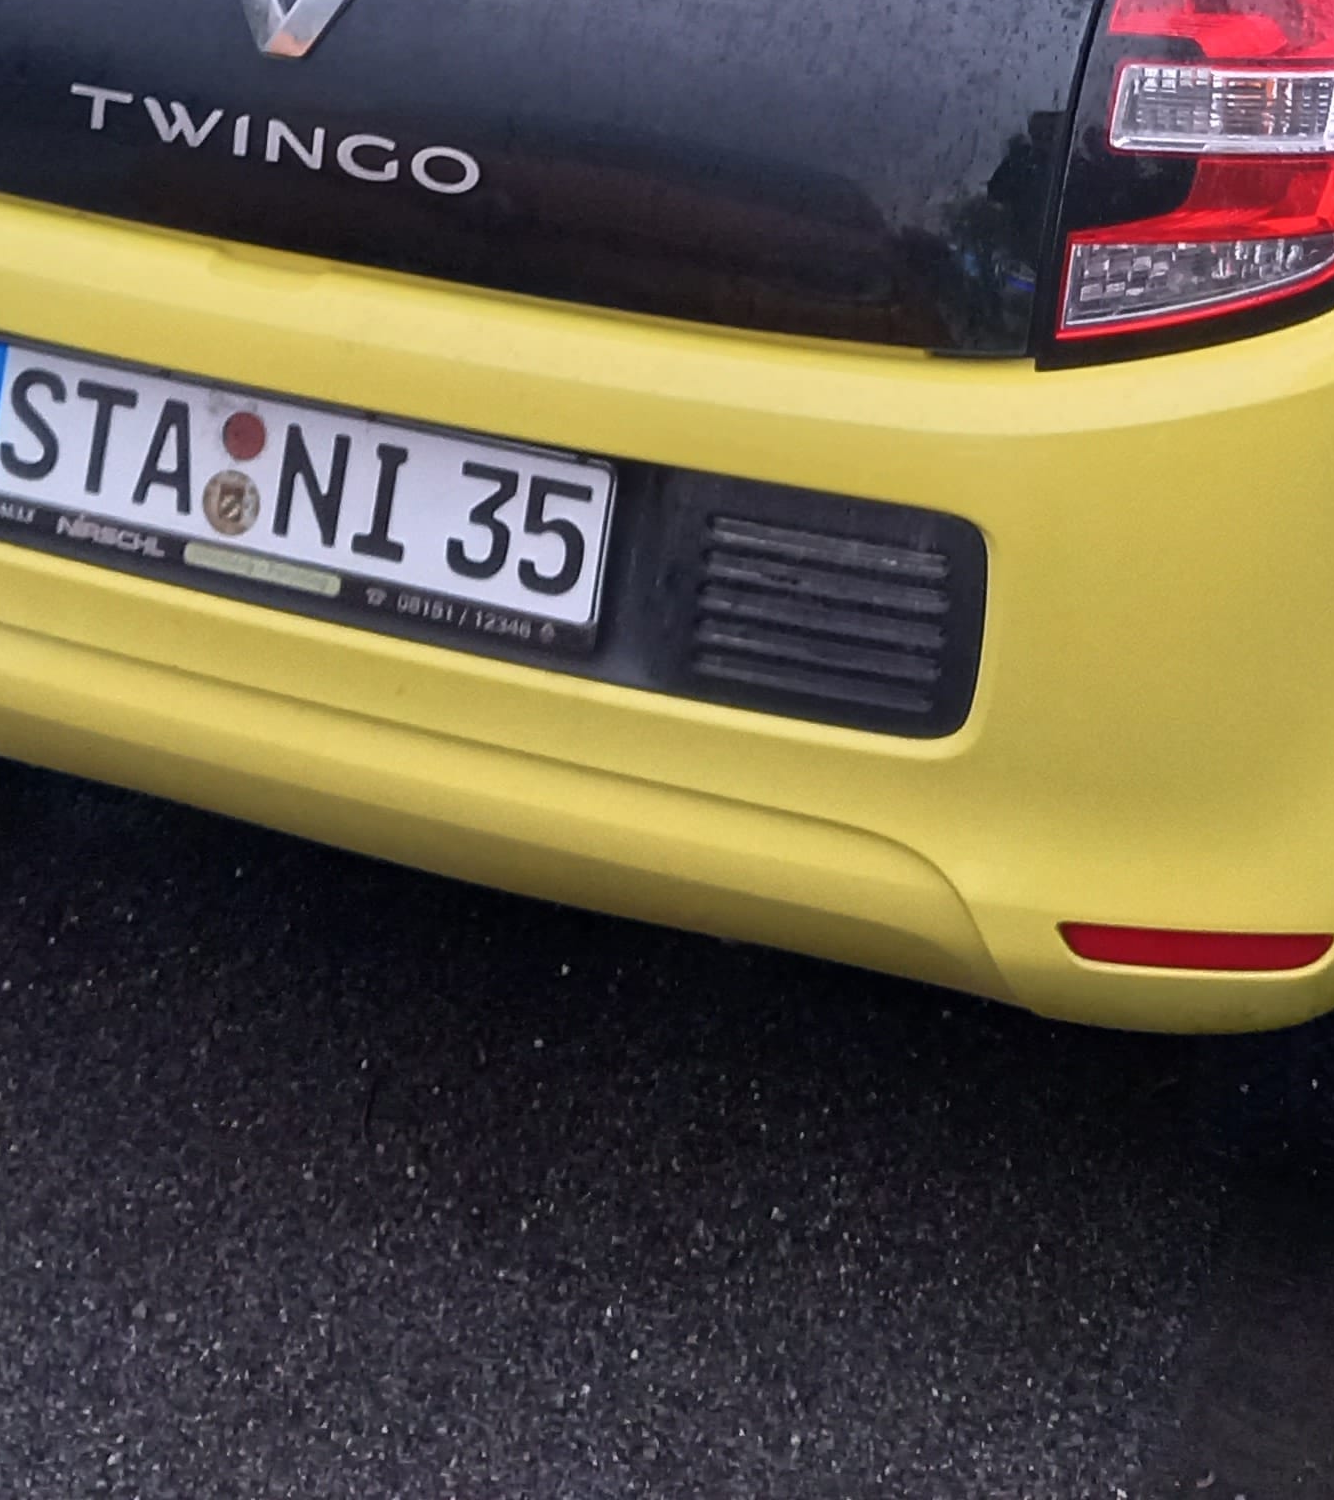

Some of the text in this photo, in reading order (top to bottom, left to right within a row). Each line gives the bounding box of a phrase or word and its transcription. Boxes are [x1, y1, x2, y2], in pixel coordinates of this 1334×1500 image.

[70, 82, 481, 194] TWINGO
[0, 367, 593, 596] STA NI 35
